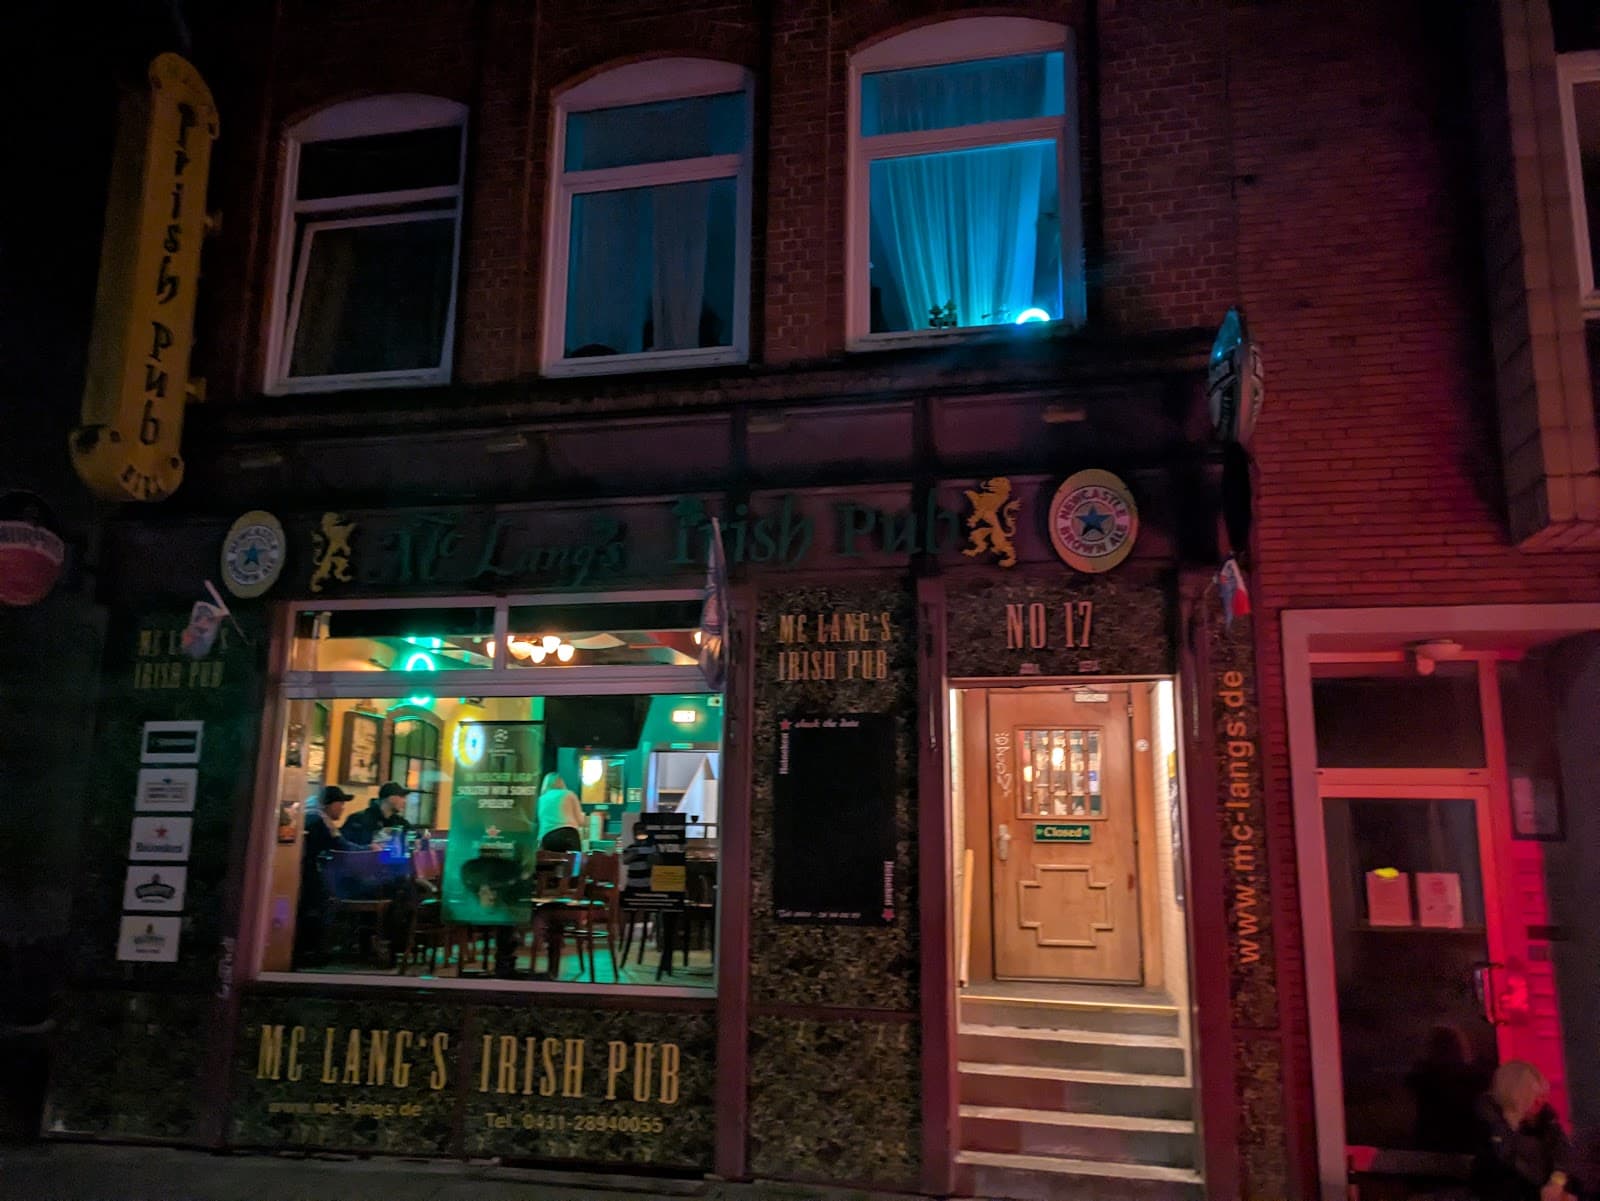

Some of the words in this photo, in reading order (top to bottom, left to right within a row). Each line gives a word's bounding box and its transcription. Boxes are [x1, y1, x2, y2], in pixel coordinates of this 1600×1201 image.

[1059, 489, 1127, 520] NEWCASTLE
[669, 496, 814, 566] Irish
[833, 487, 962, 558] Pub
[1060, 525, 1107, 554] BROWN
[1110, 525, 1128, 547] ALE
[778, 613, 808, 643] MC
[816, 611, 891, 642] LANG'S
[1006, 602, 1047, 650] NO
[1063, 600, 1093, 649] 17
[778, 651, 836, 681] IRISH
[847, 649, 888, 679] PUB
[1044, 826, 1083, 838] Closed
[1219, 670, 1260, 963] www.mc-langs.de
[256, 1024, 305, 1081] MC
[320, 1026, 449, 1090] LANG'S
[479, 1034, 585, 1098] IRISH
[604, 1040, 681, 1104] PUB
